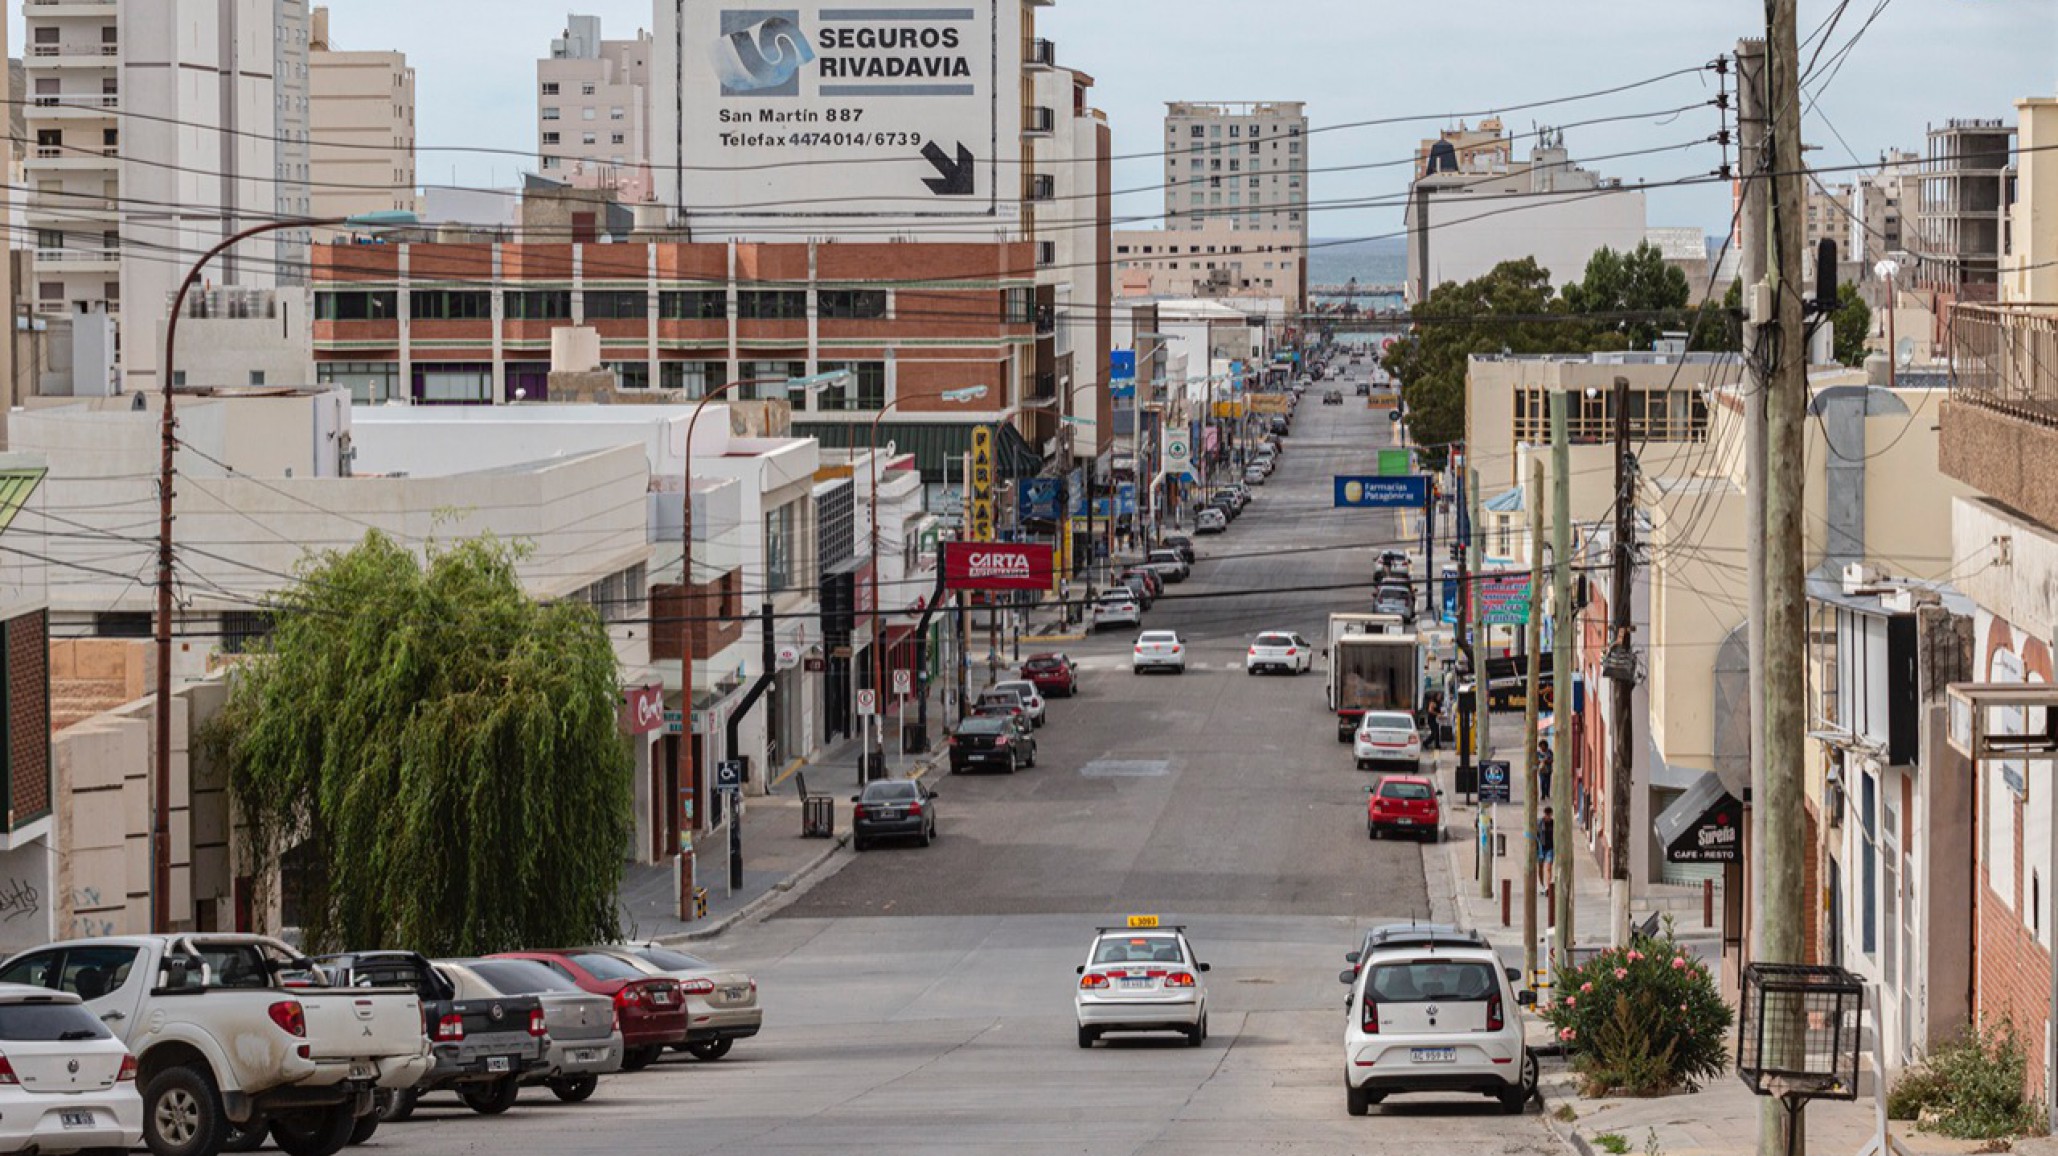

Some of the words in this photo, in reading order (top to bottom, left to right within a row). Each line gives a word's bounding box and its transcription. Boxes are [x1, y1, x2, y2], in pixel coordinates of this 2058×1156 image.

[819, 28, 960, 49] SEGUROS
[819, 57, 971, 77] RIVADAVIA
[719, 108, 752, 123] San
[759, 108, 818, 123] Martín
[826, 108, 864, 122] 887
[720, 132, 786, 147] Telefax
[789, 132, 921, 147] 4474014/6739
[1364, 482, 1408, 491] Farmacias
[968, 552, 1030, 568] CARTA
[1697, 826, 1736, 846] Sureña
[1674, 850, 1698, 859] CAFE
[1703, 850, 1734, 859] RESTO
